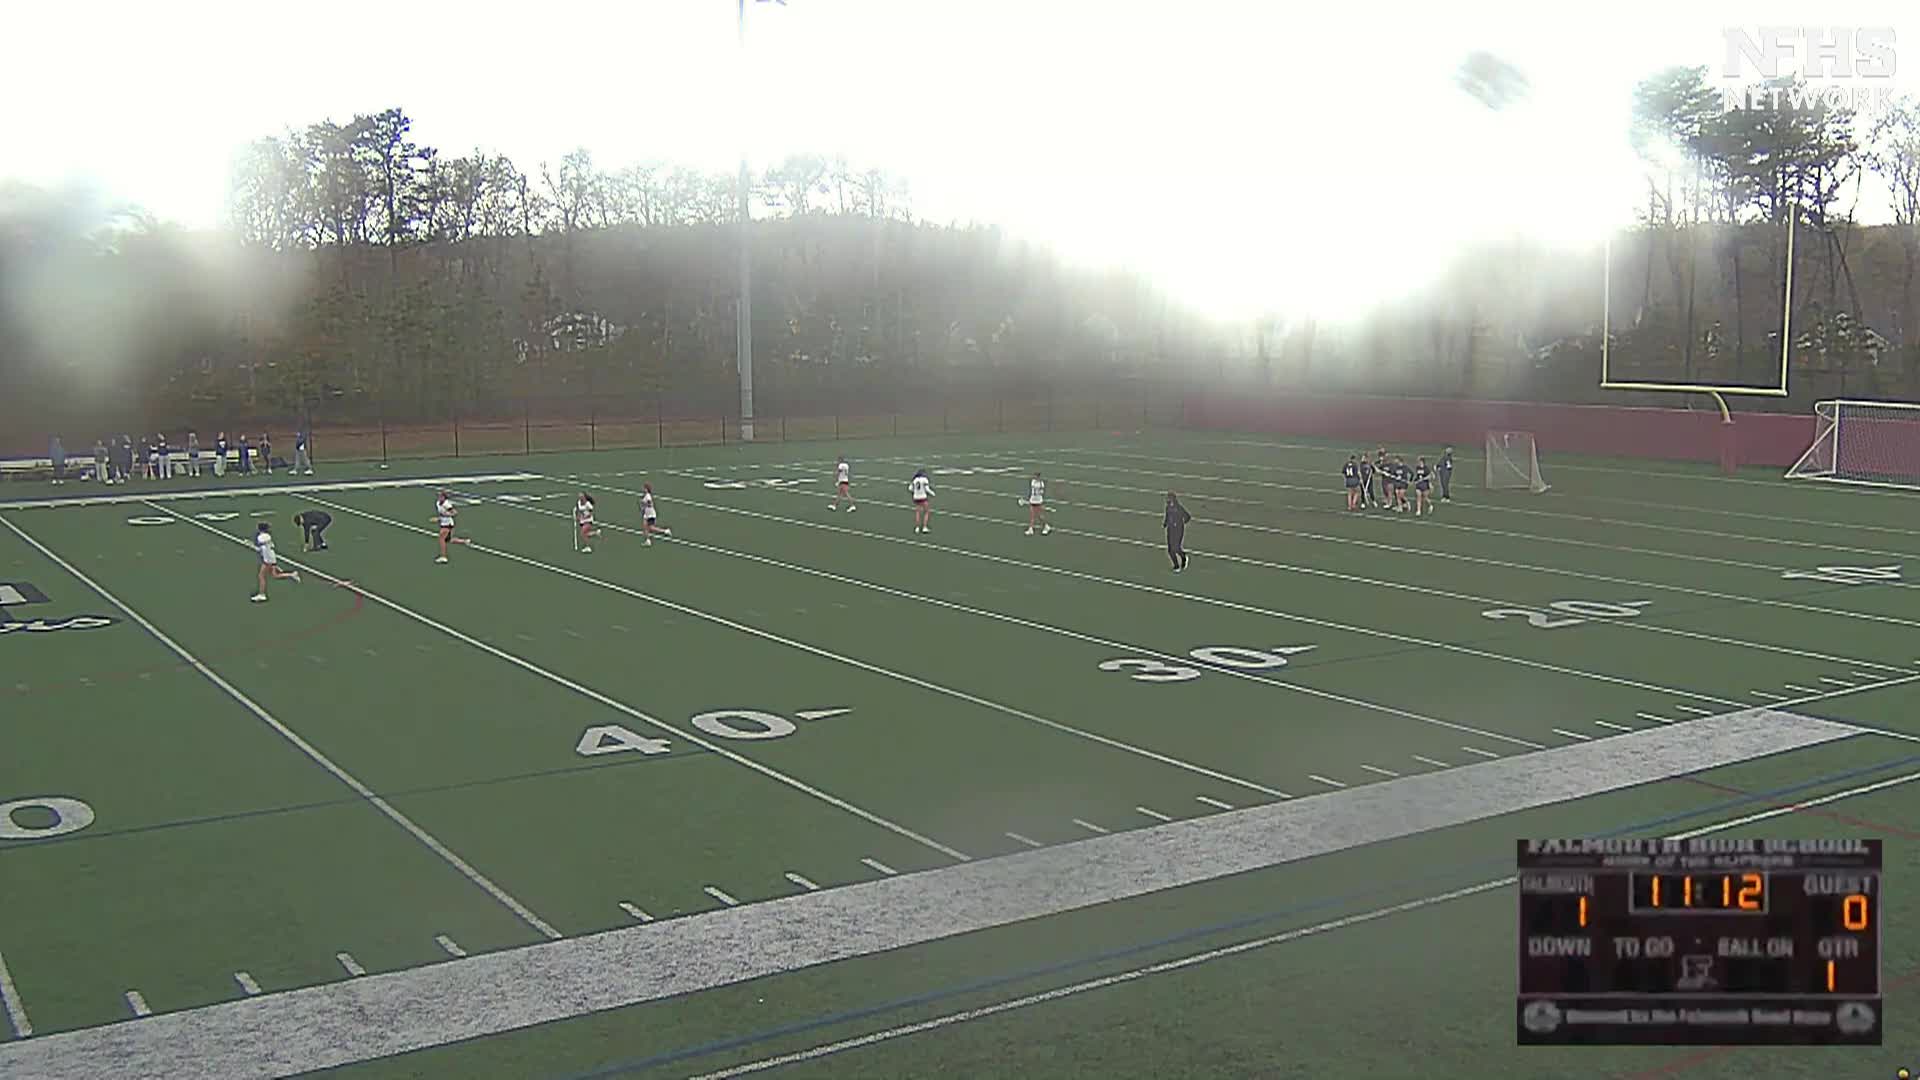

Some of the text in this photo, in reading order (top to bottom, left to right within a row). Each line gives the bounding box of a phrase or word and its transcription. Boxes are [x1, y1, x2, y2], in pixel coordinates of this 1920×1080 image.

[1481, 600, 1642, 628] 20
[1099, 646, 1287, 682] 30
[575, 709, 797, 757] 40
